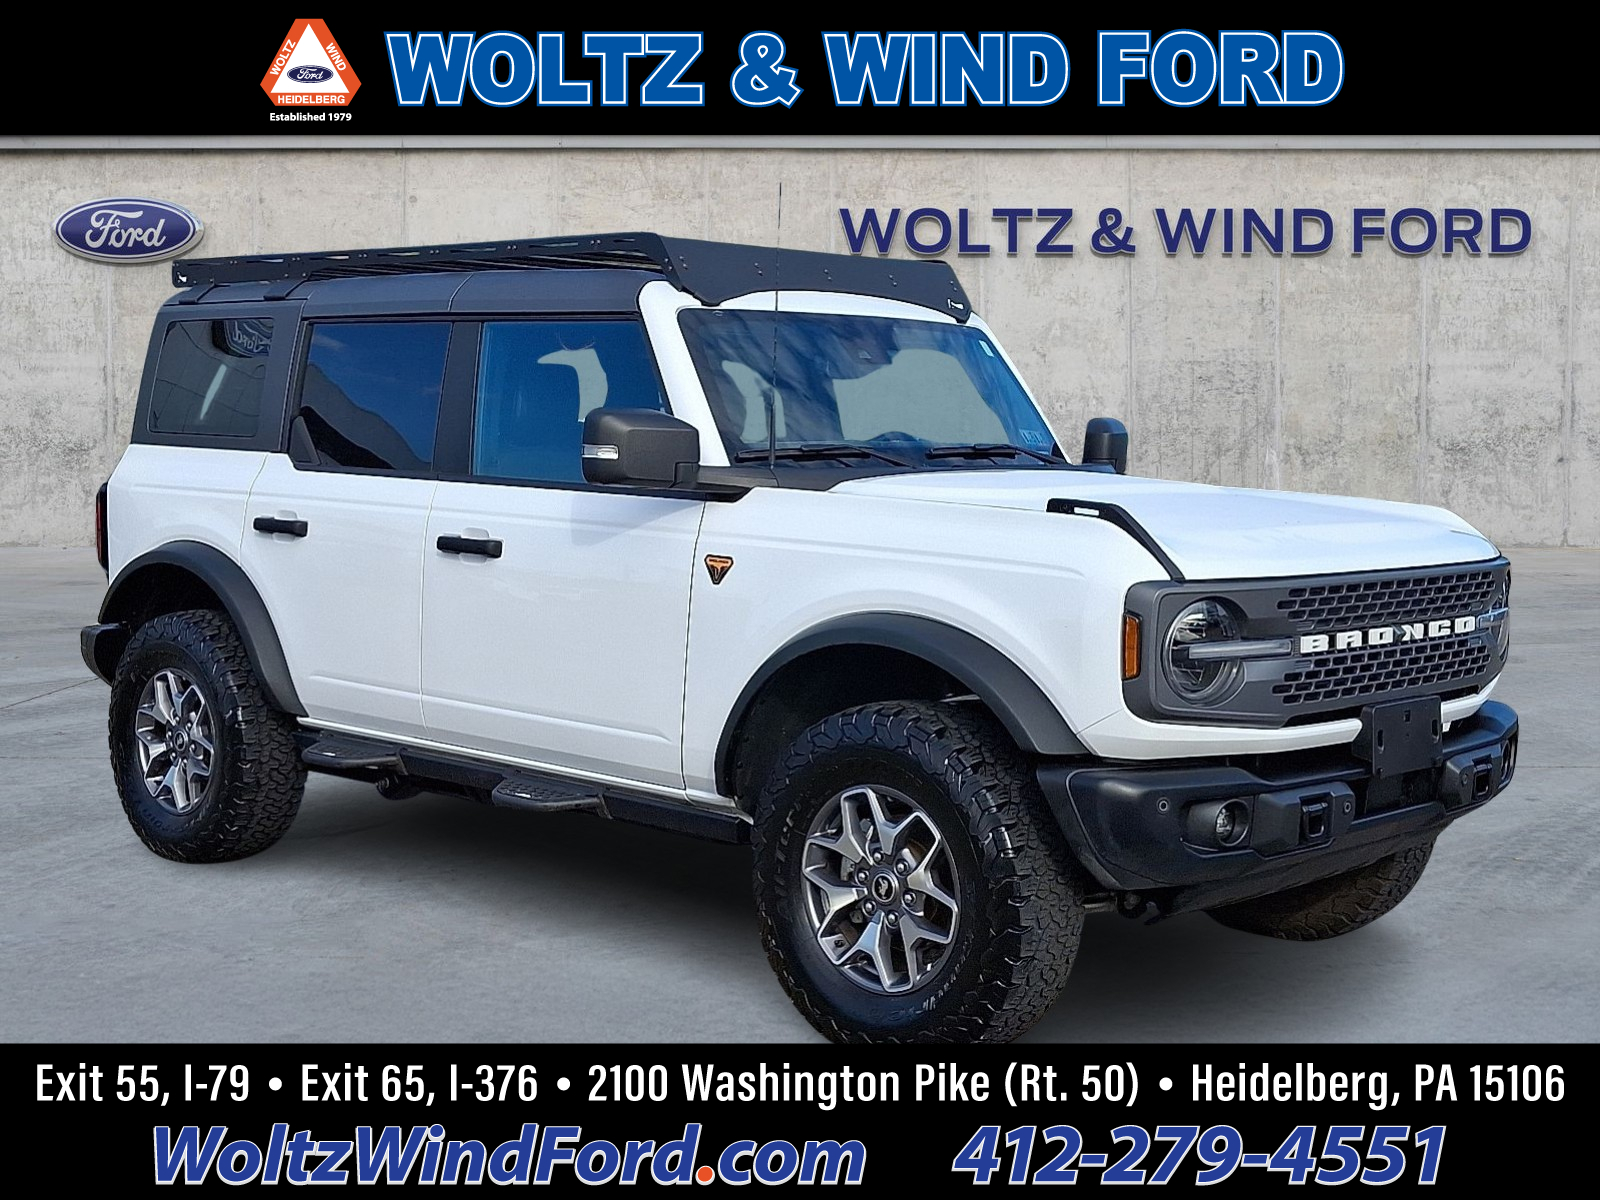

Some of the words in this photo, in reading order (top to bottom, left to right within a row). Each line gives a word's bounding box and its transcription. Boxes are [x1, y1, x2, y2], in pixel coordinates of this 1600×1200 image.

[85, 209, 166, 248] Ford
[839, 207, 1073, 254] WOLTZ
[1090, 207, 1136, 254] &
[1155, 207, 1334, 254] WIND
[1351, 207, 1533, 254] FORD
[1300, 615, 1476, 654] BRONCO
